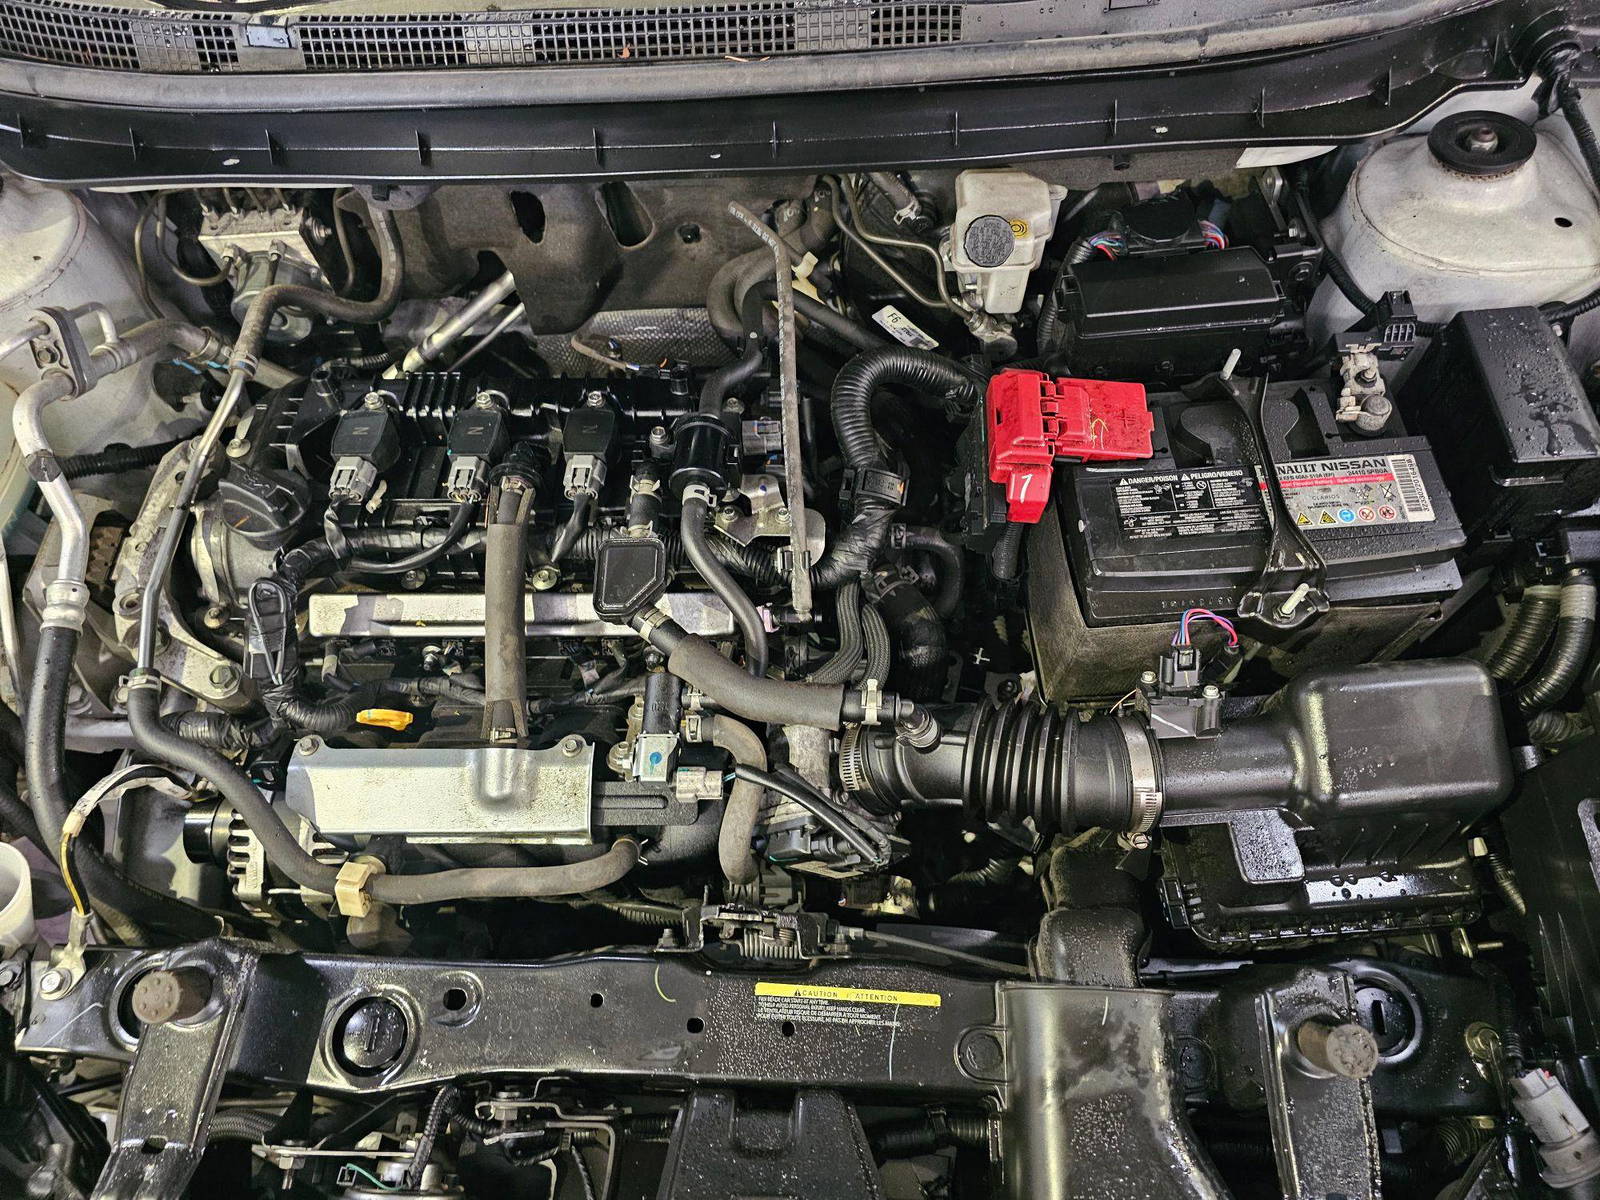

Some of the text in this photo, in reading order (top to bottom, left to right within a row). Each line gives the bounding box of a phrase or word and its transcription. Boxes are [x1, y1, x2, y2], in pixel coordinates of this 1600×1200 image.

[1322, 458, 1387, 472] NISSAN
[1127, 469, 1243, 485] DANGER/POISON PELIGRO/VENENO
[802, 989, 838, 998] CAUTION
[855, 993, 898, 1002] ATTENTION
